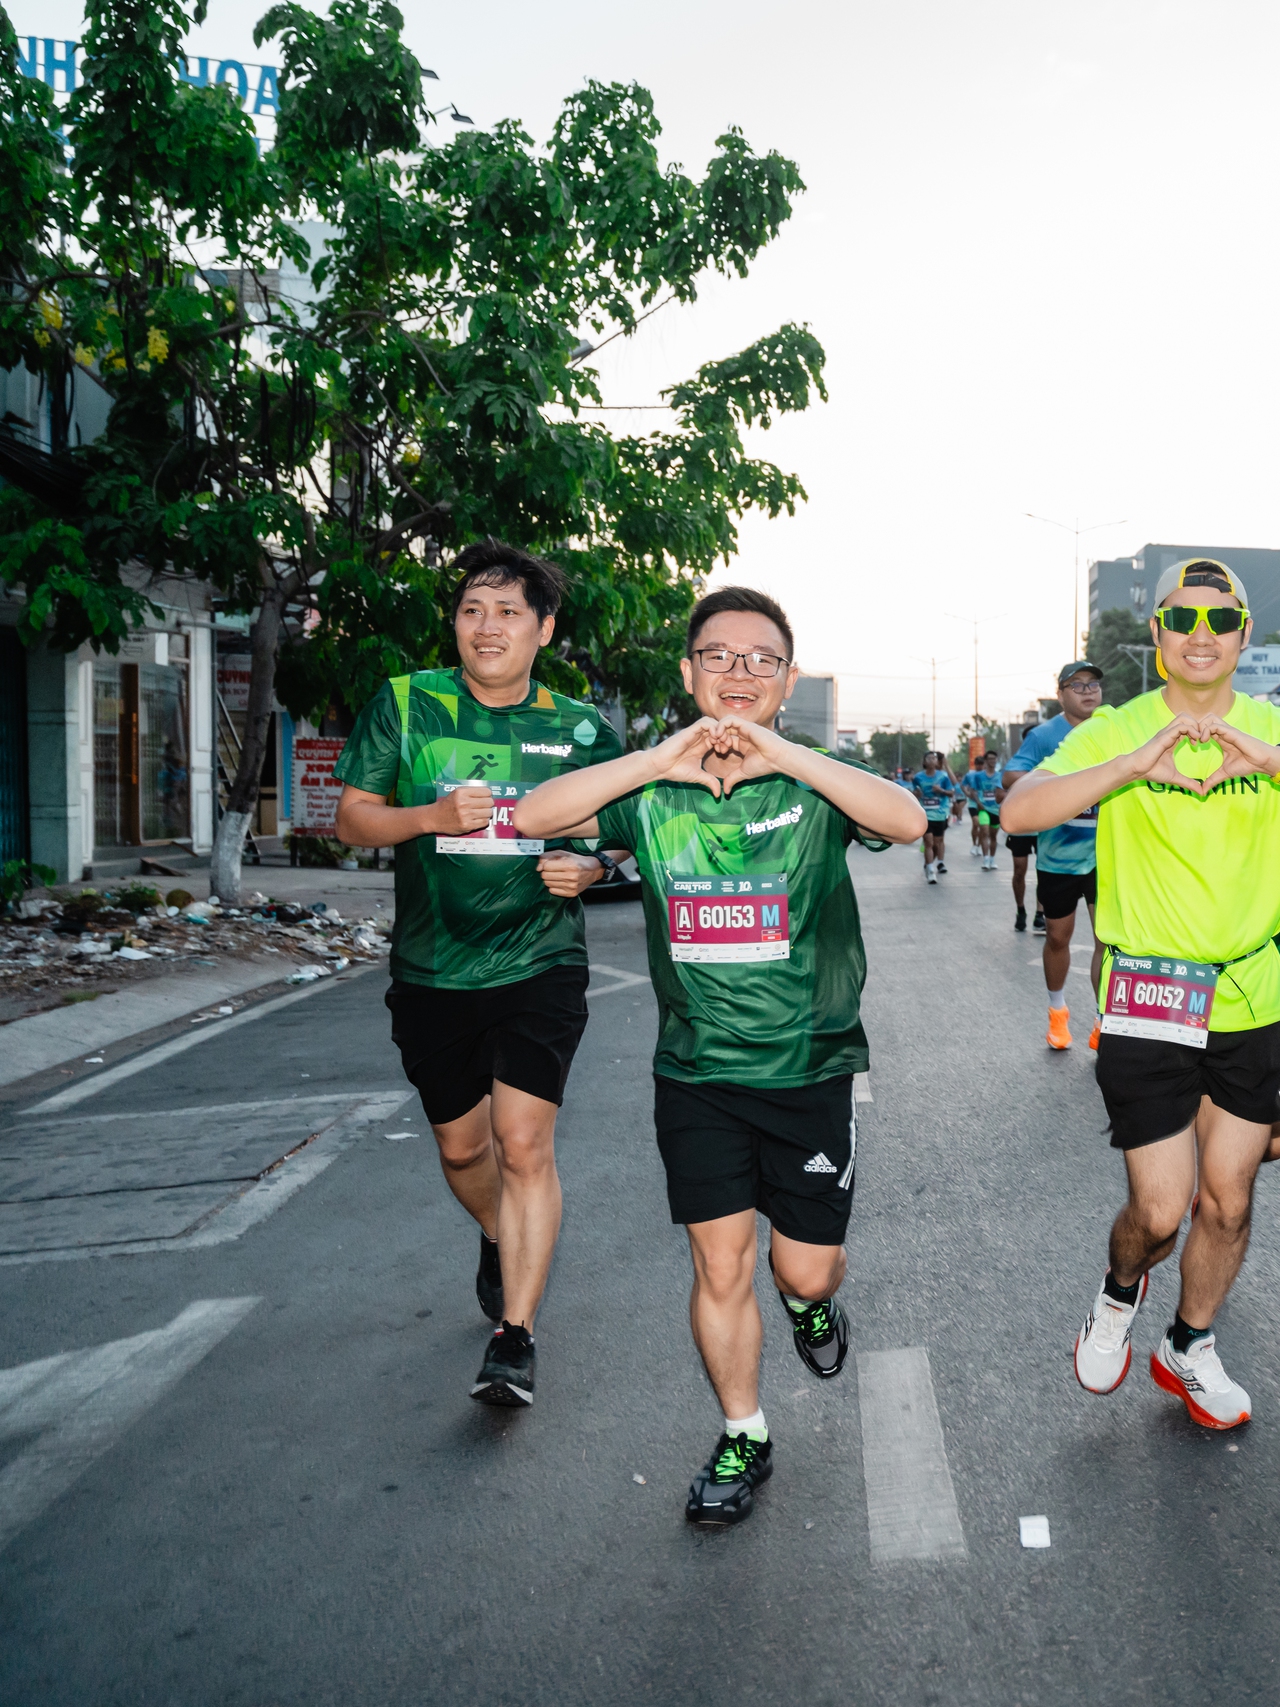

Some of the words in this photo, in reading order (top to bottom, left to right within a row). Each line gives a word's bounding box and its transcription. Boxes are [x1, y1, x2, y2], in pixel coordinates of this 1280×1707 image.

[16, 36, 77, 93] NH
[521, 743, 568, 757] Herbalife
[746, 812, 799, 836] Herbalife
[679, 906, 691, 928] A
[699, 905, 755, 929] 60153
[762, 904, 779, 927] M
[1115, 980, 1127, 1003] A
[1134, 981, 1185, 1010] 60152
[1188, 990, 1207, 1014] M
[803, 1164, 837, 1173] adidas
